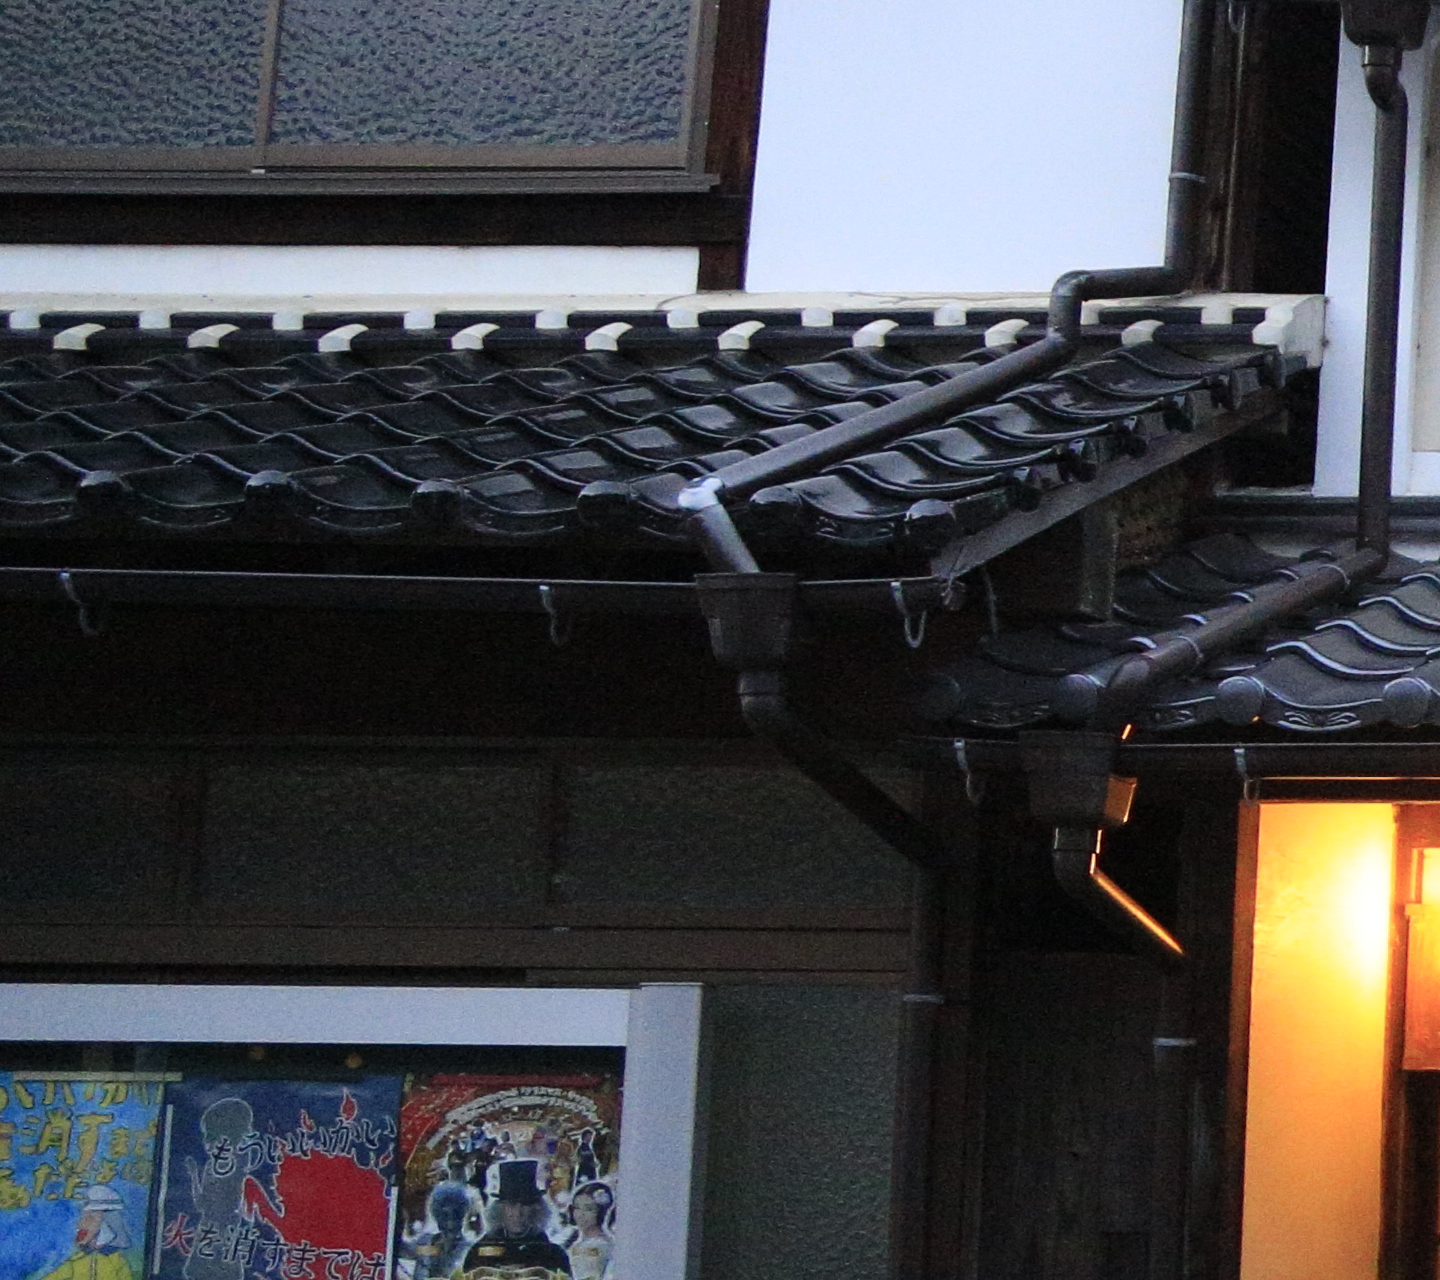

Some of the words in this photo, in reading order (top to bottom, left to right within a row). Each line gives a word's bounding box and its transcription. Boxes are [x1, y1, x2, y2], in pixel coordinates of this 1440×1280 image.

[212, 1115, 397, 1177] もういいかい
